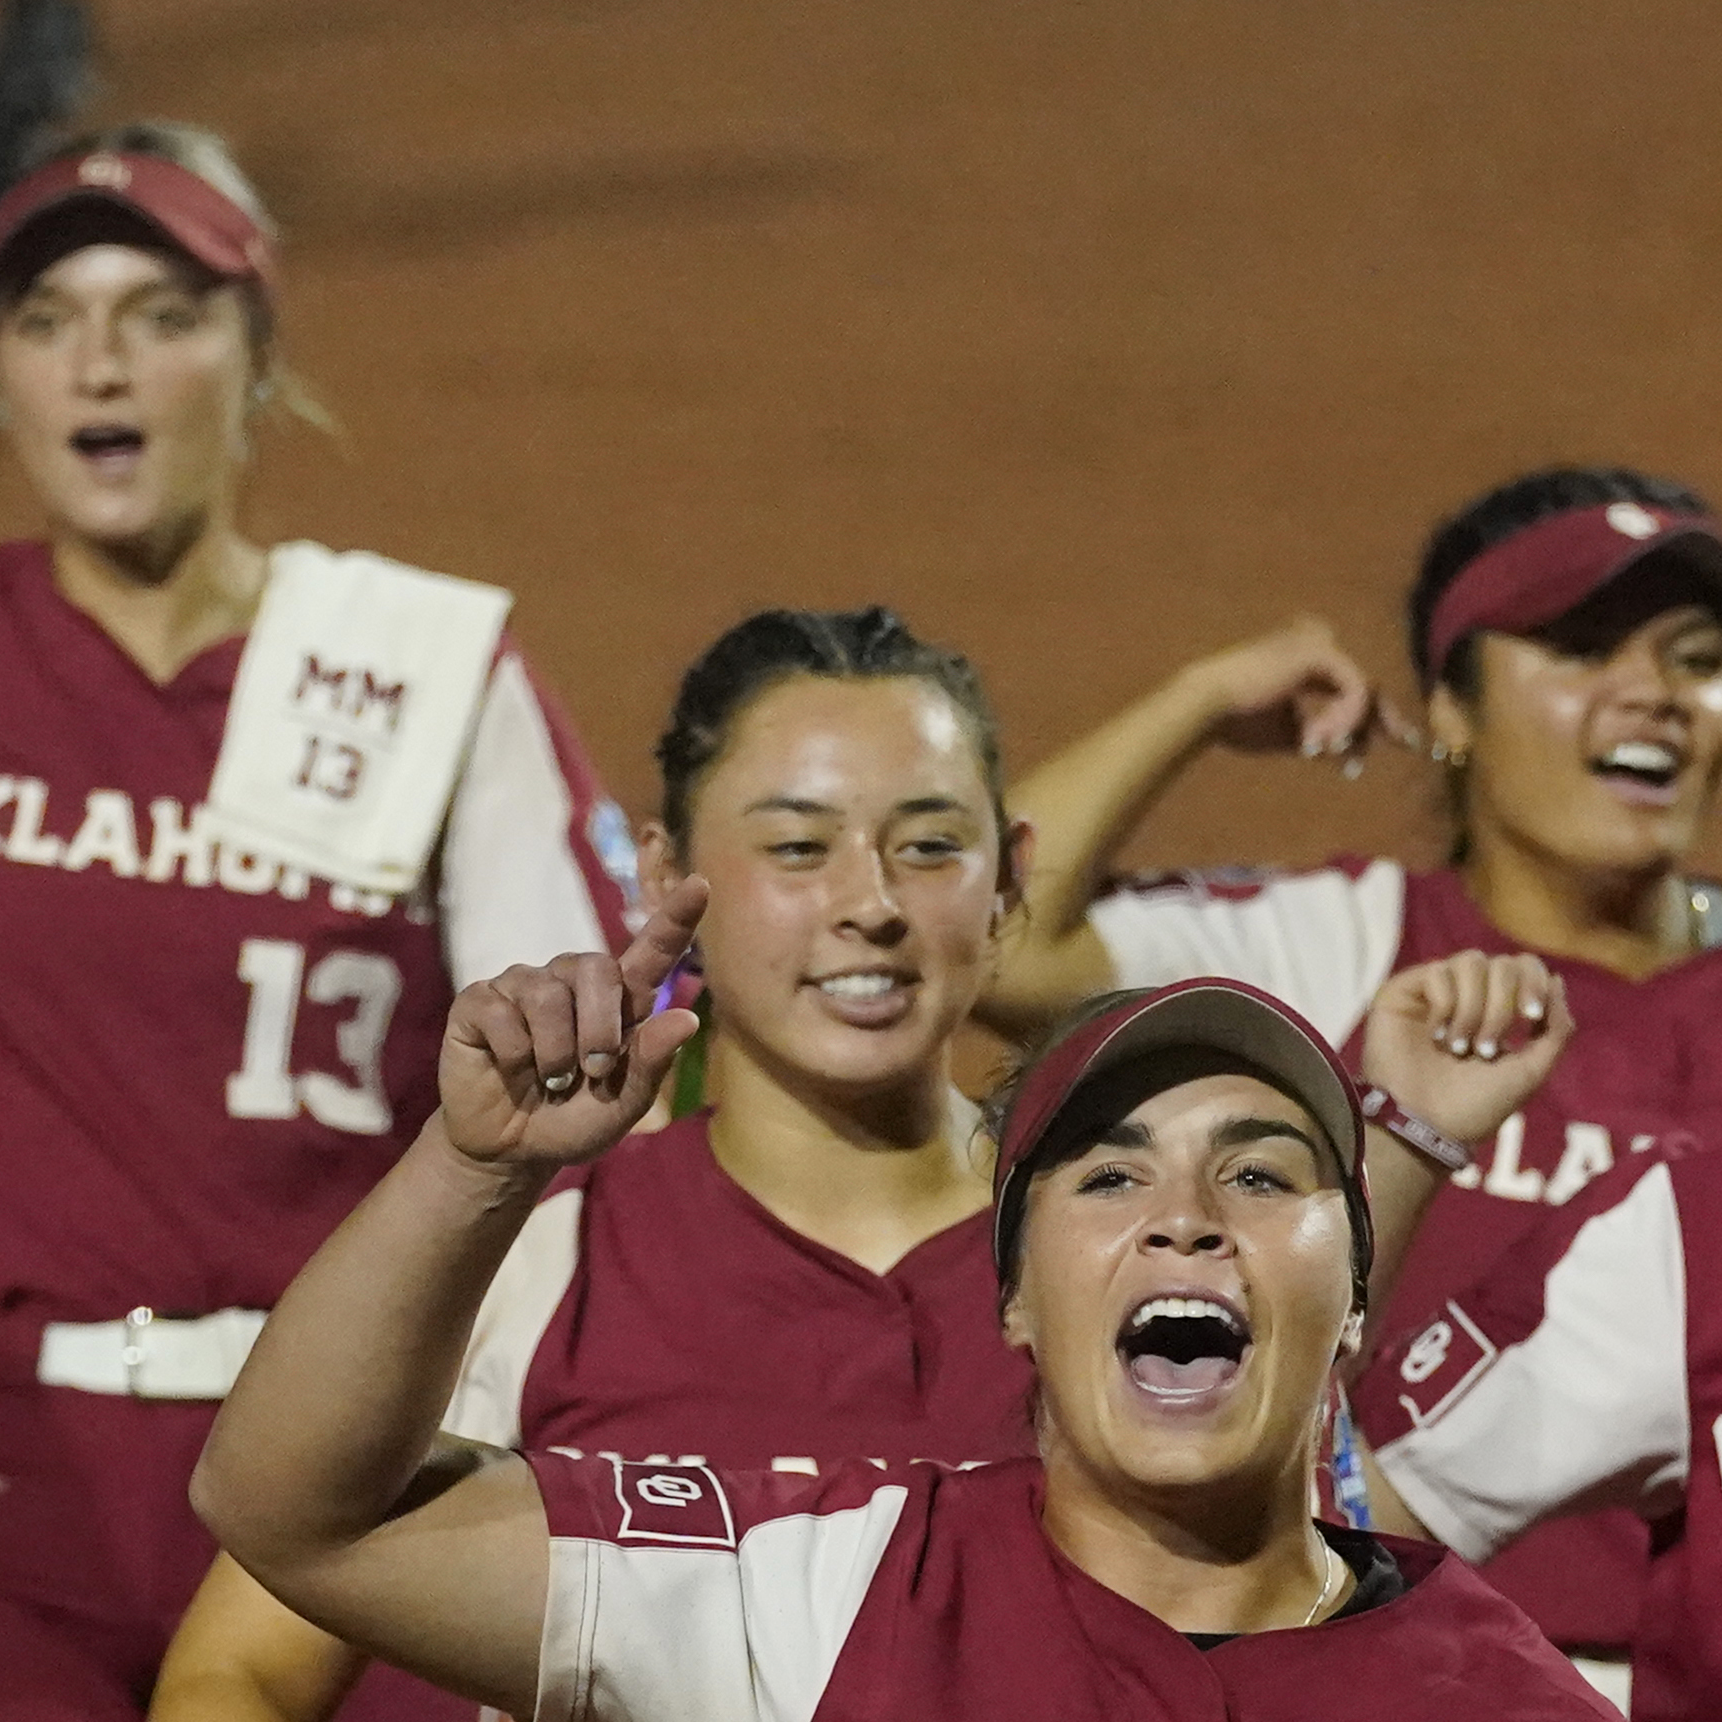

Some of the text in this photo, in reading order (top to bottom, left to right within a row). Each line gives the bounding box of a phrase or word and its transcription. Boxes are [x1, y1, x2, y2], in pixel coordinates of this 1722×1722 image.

[295, 653, 406, 733] MM
[293, 734, 367, 802] 13
[225, 937, 404, 1134] 13
